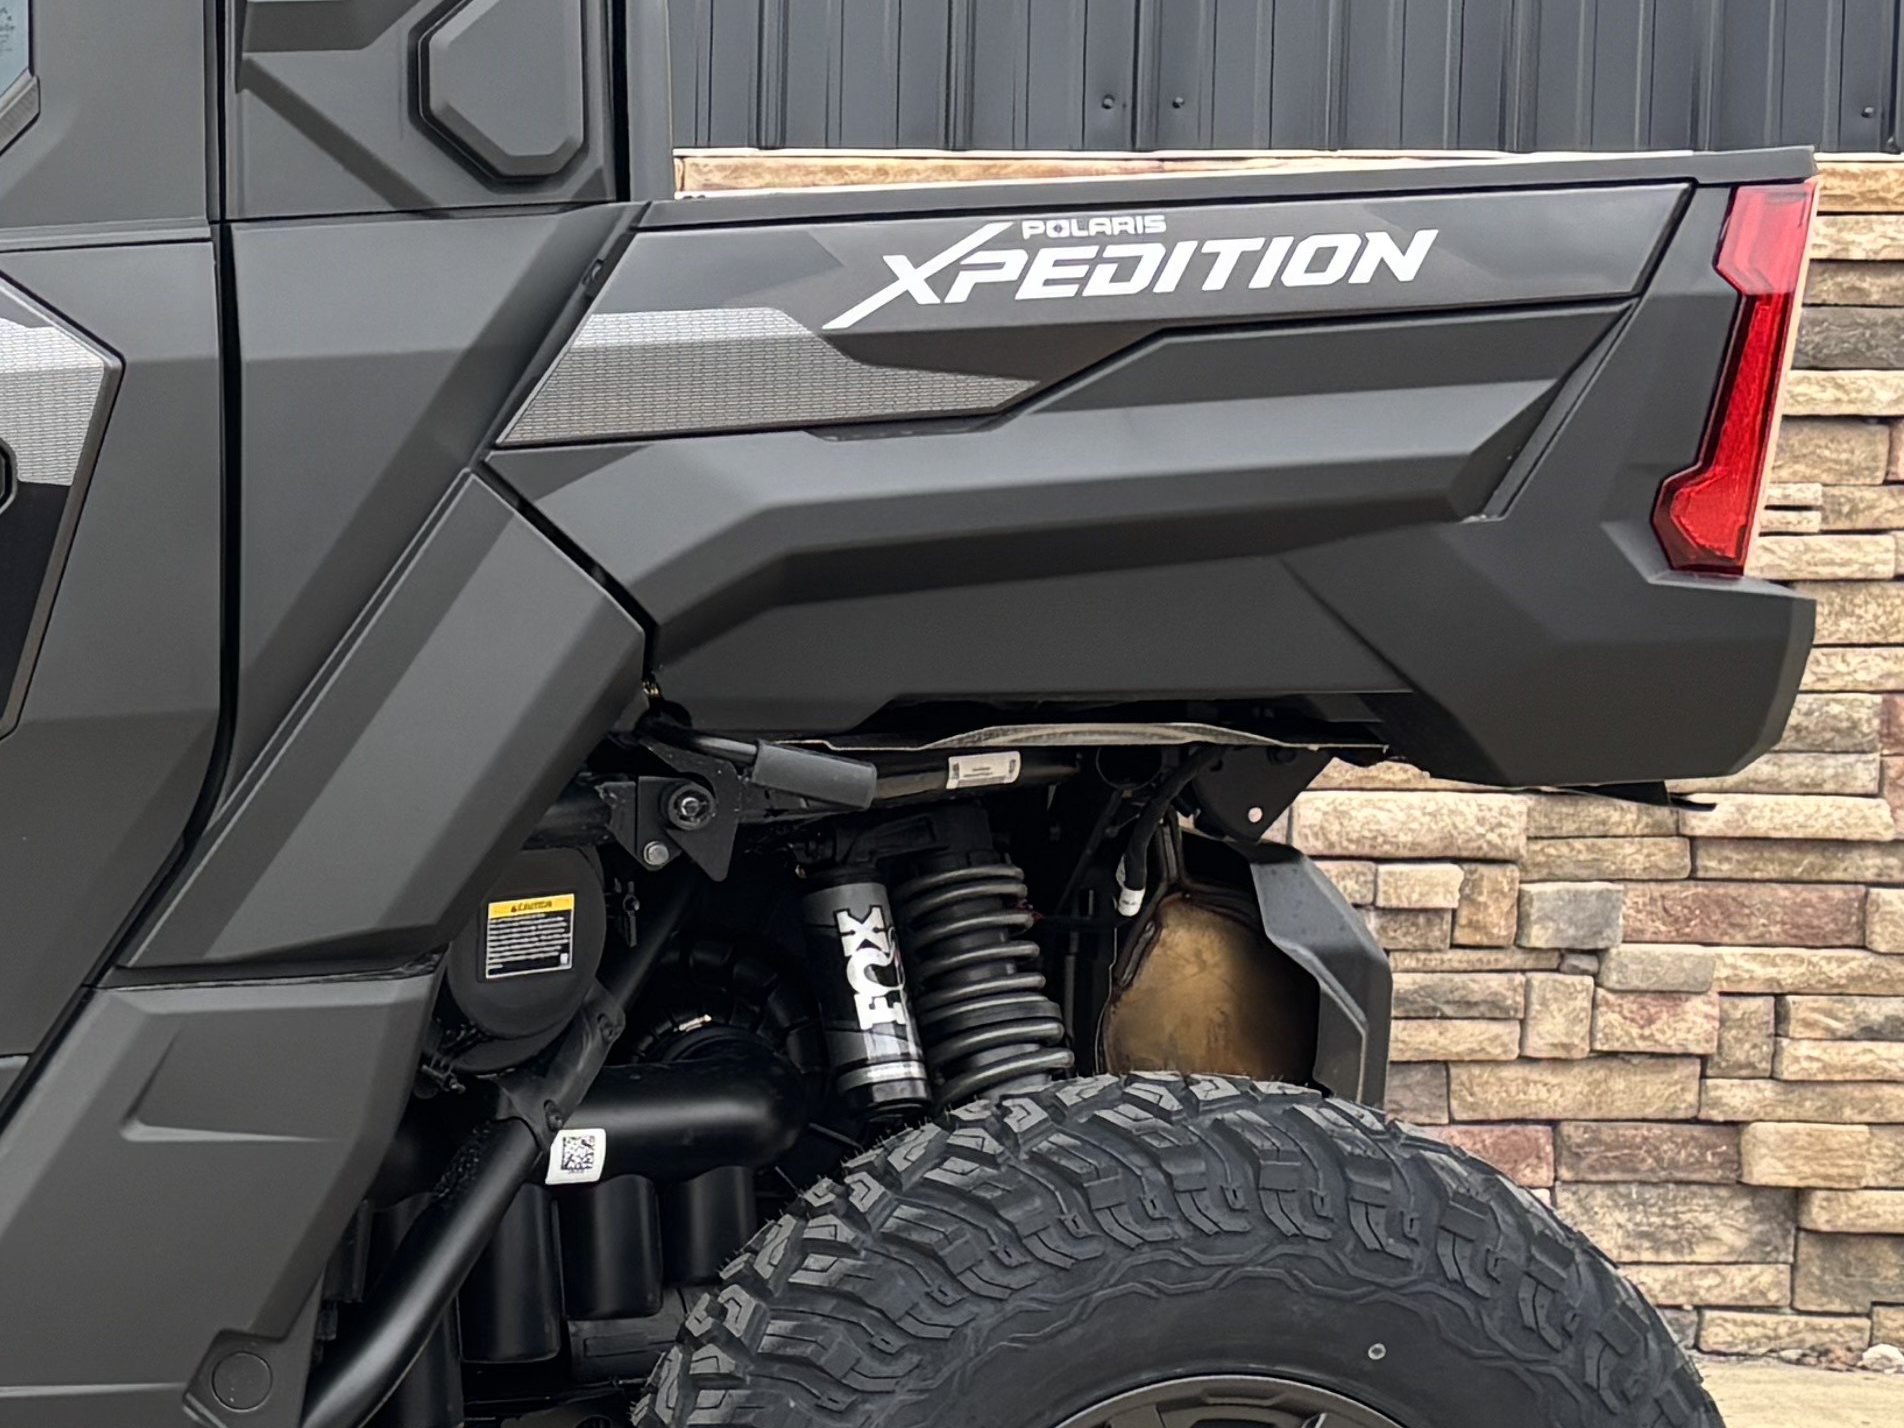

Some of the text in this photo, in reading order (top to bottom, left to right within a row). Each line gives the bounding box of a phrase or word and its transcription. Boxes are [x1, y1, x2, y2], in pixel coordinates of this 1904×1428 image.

[821, 221, 1440, 330] XPEDITION
[1021, 214, 1167, 240] POLARIS
[835, 904, 907, 1031] FOX
